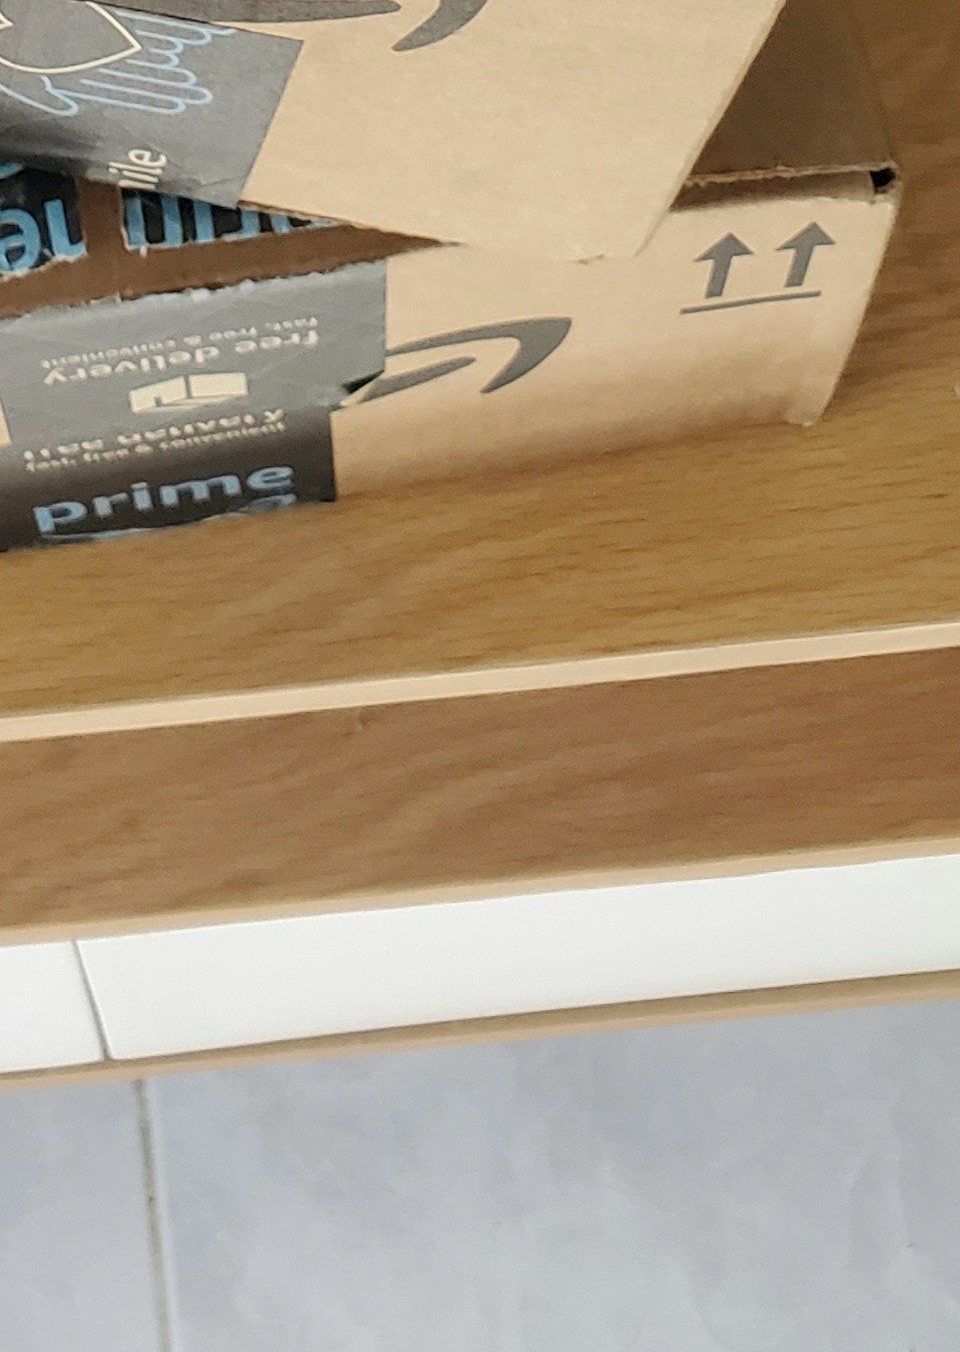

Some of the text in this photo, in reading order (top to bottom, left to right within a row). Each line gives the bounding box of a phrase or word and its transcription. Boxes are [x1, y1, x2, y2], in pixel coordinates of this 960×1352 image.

[43, 329, 321, 386] free delivery
[31, 465, 295, 534] prime
